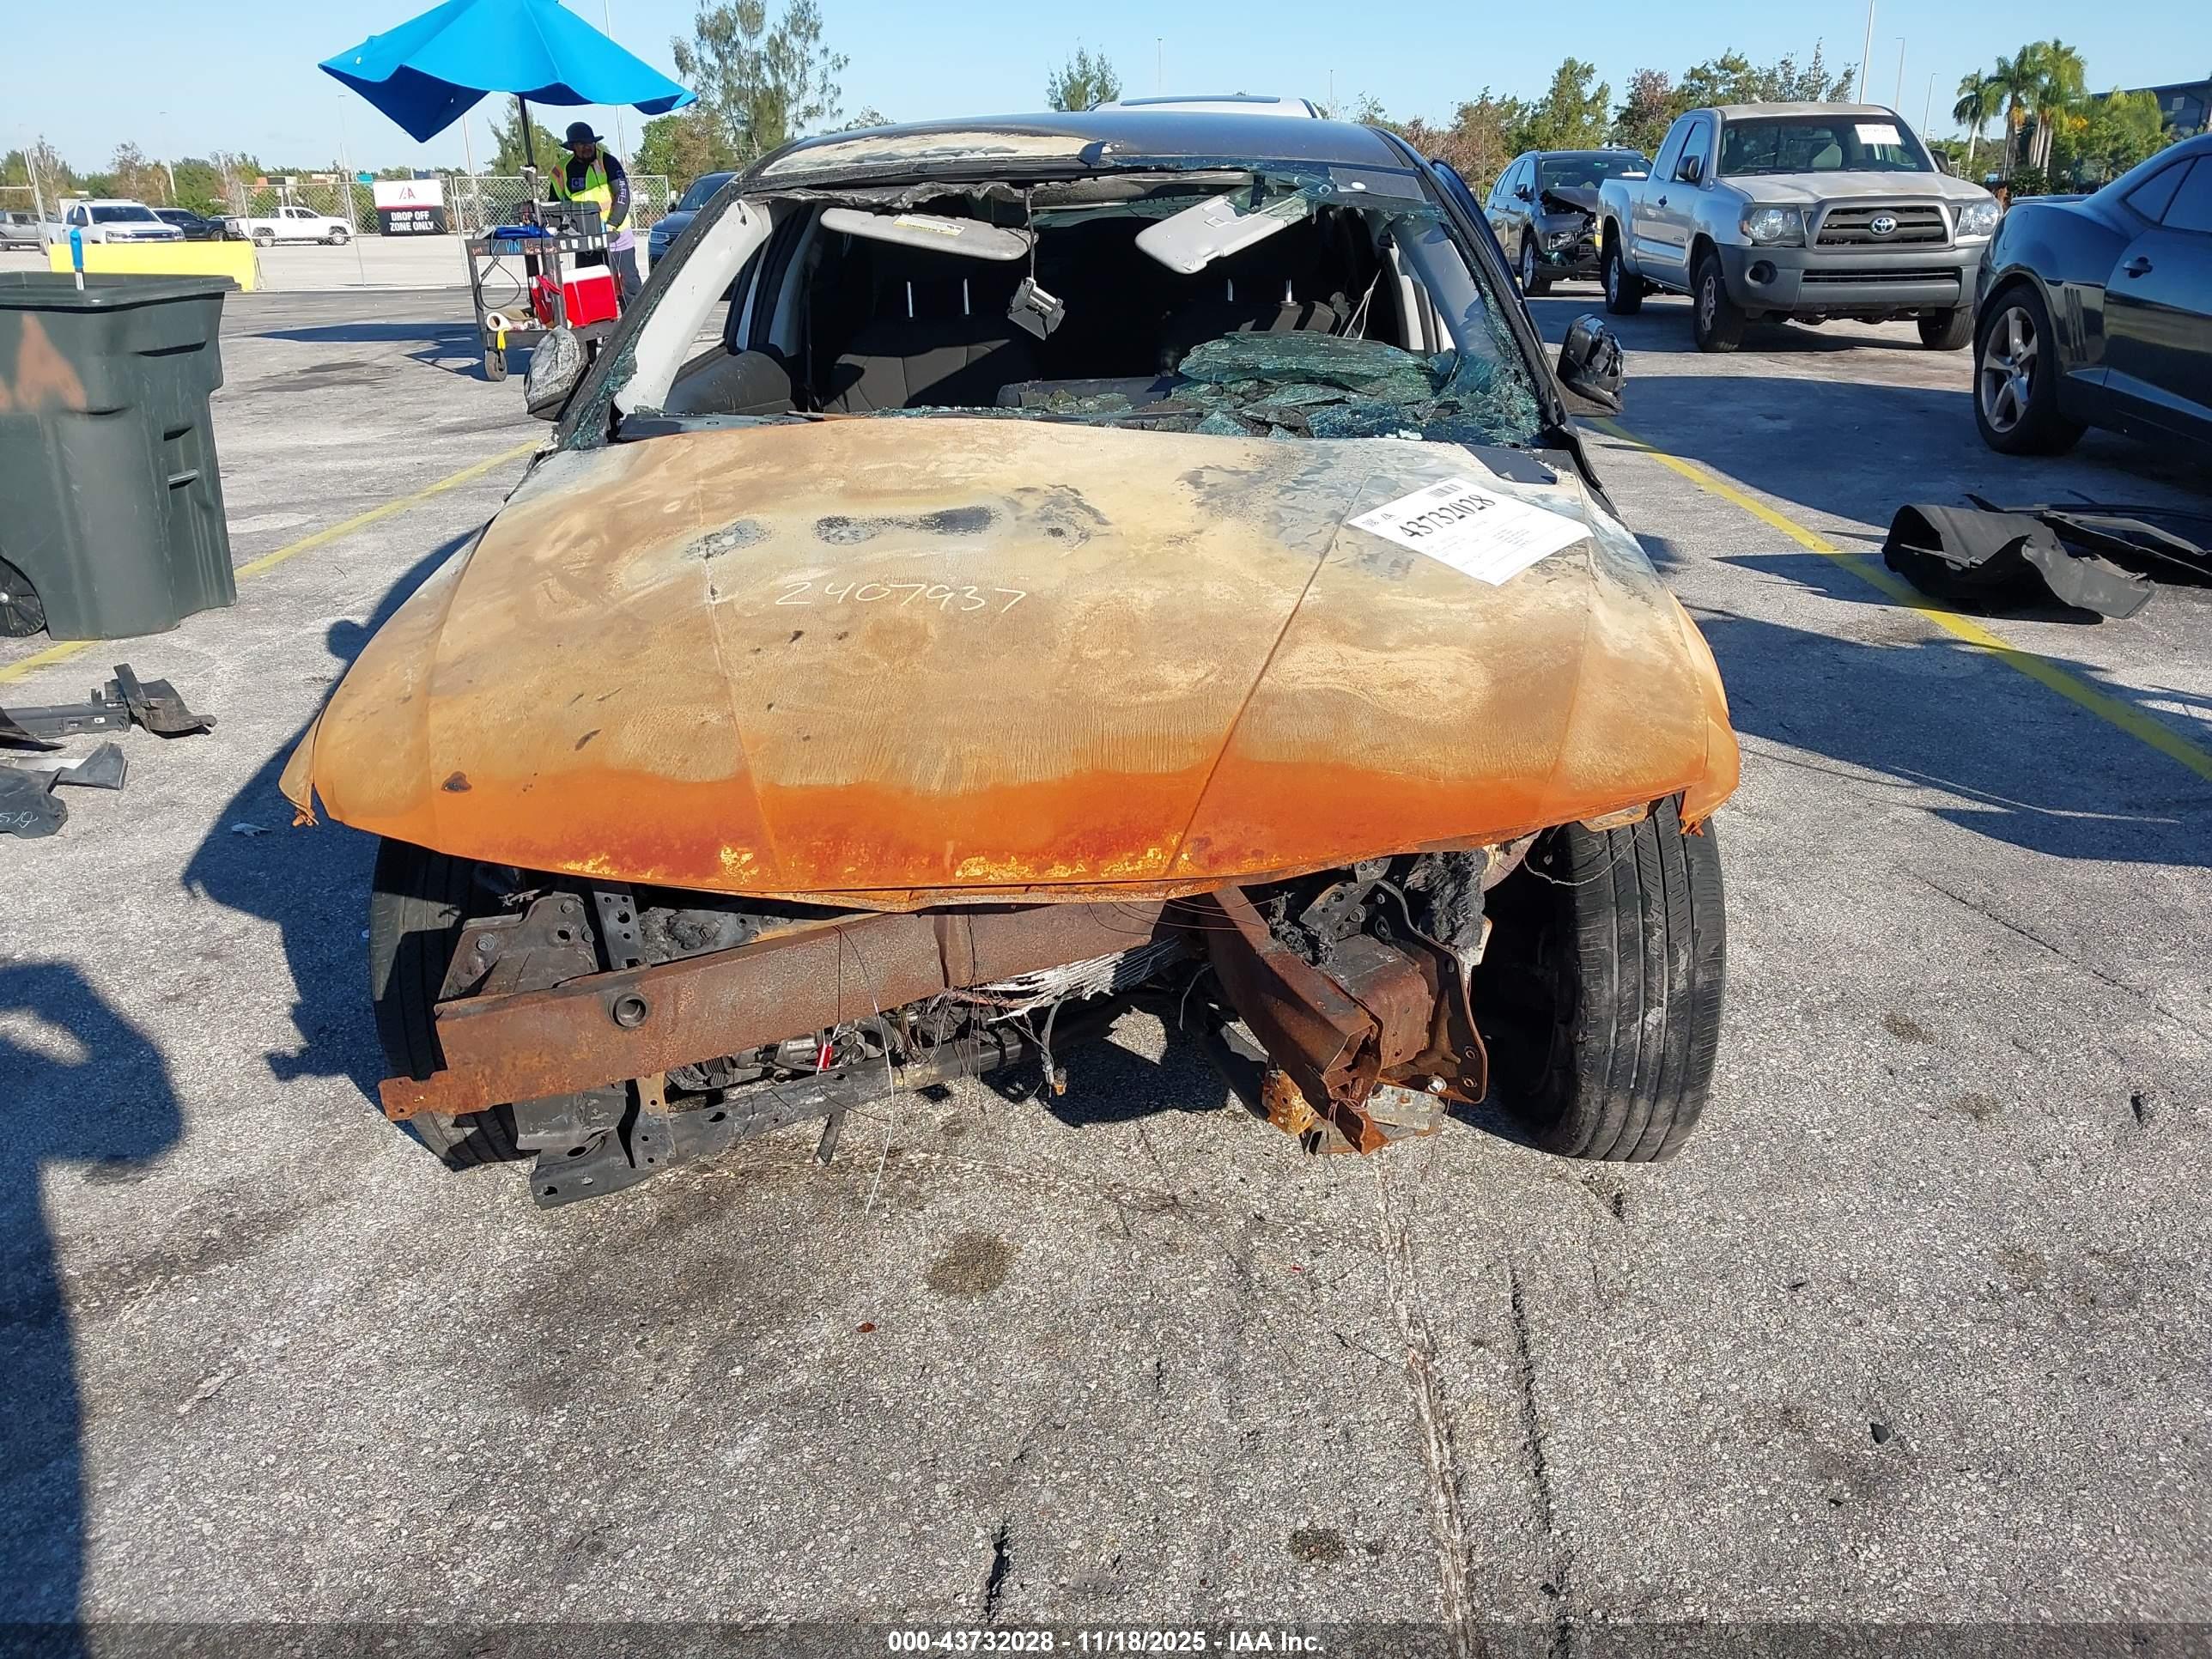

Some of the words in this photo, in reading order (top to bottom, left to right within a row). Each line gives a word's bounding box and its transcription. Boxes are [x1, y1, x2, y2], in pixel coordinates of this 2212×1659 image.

[390, 211, 413, 222] DROP
[414, 210, 429, 221] OFF
[389, 222, 412, 232] ZONE
[412, 221, 434, 231] ONLY
[505, 240, 520, 254] VIN
[1399, 495, 1496, 538] 43732028
[775, 581, 1027, 613] 2407937
